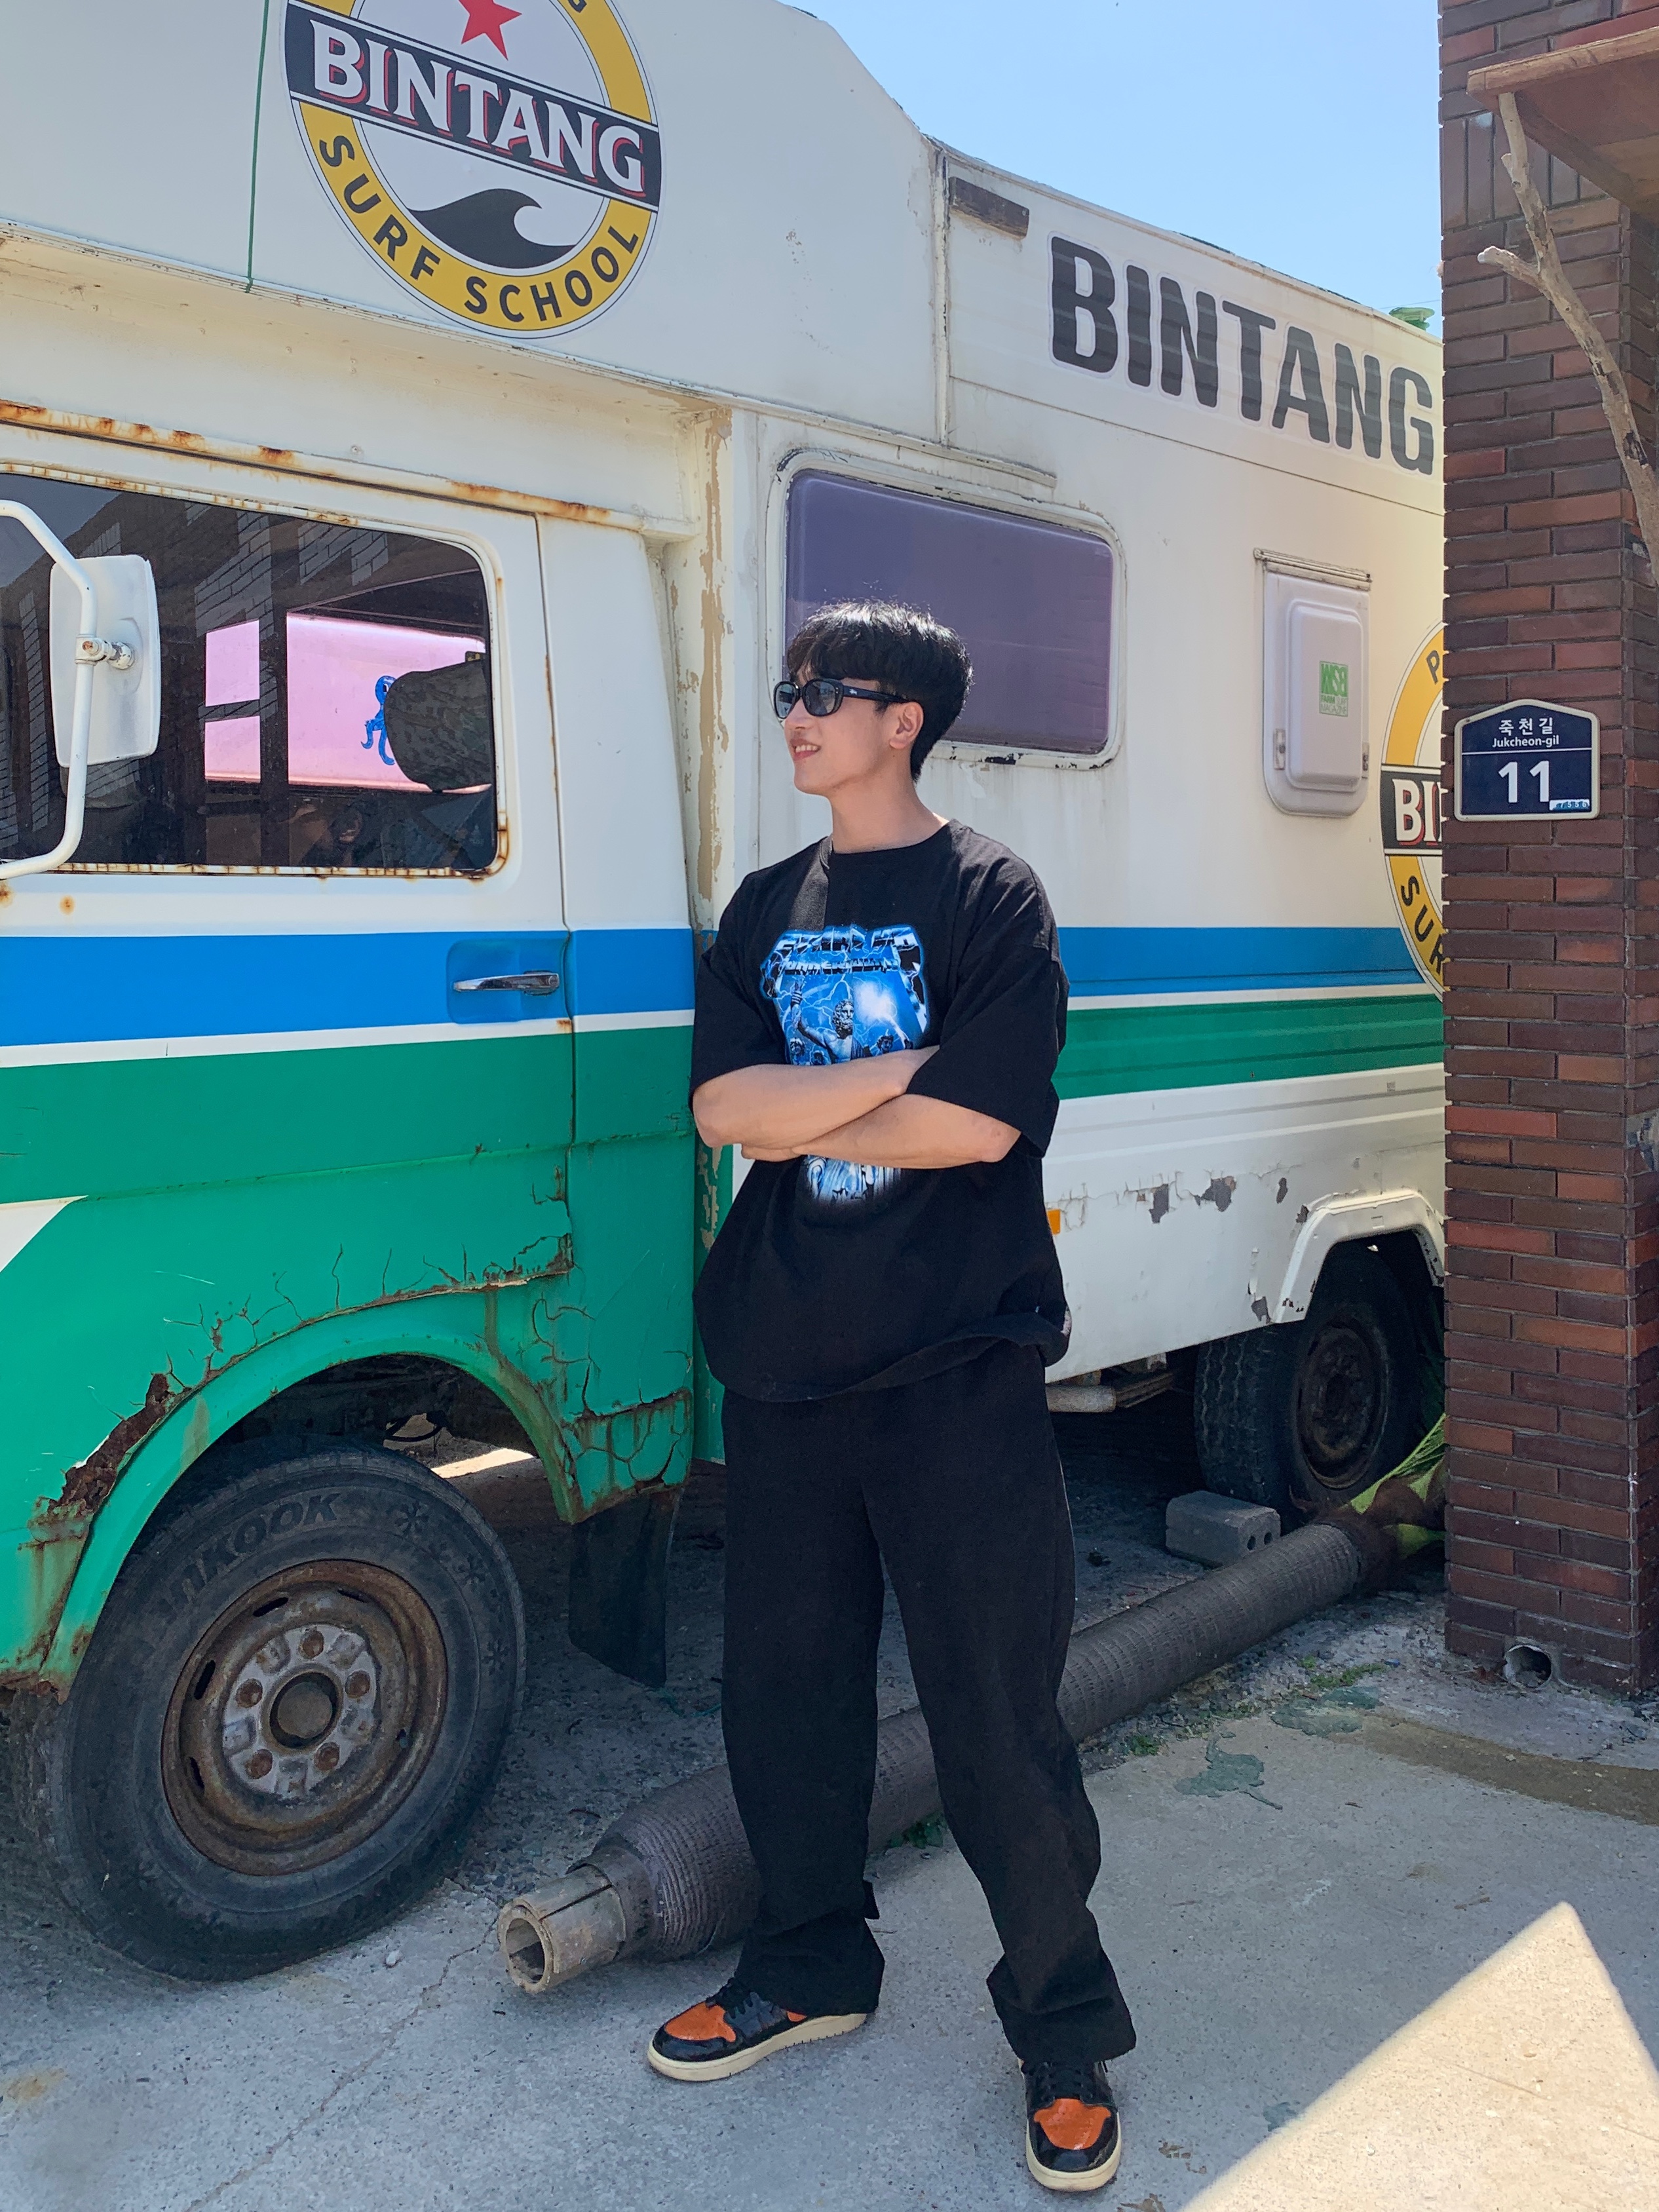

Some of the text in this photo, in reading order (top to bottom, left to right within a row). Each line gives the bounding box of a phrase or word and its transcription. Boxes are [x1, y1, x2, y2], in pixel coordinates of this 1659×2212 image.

[311, 19, 646, 196] BINTANG
[320, 136, 639, 322] SURF SCHOOL
[1051, 236, 1434, 476] BINTANG
[1492, 734, 1559, 748] Jukcheon-gil
[1498, 717, 1554, 736] 죽천길
[1498, 760, 1550, 803] 11
